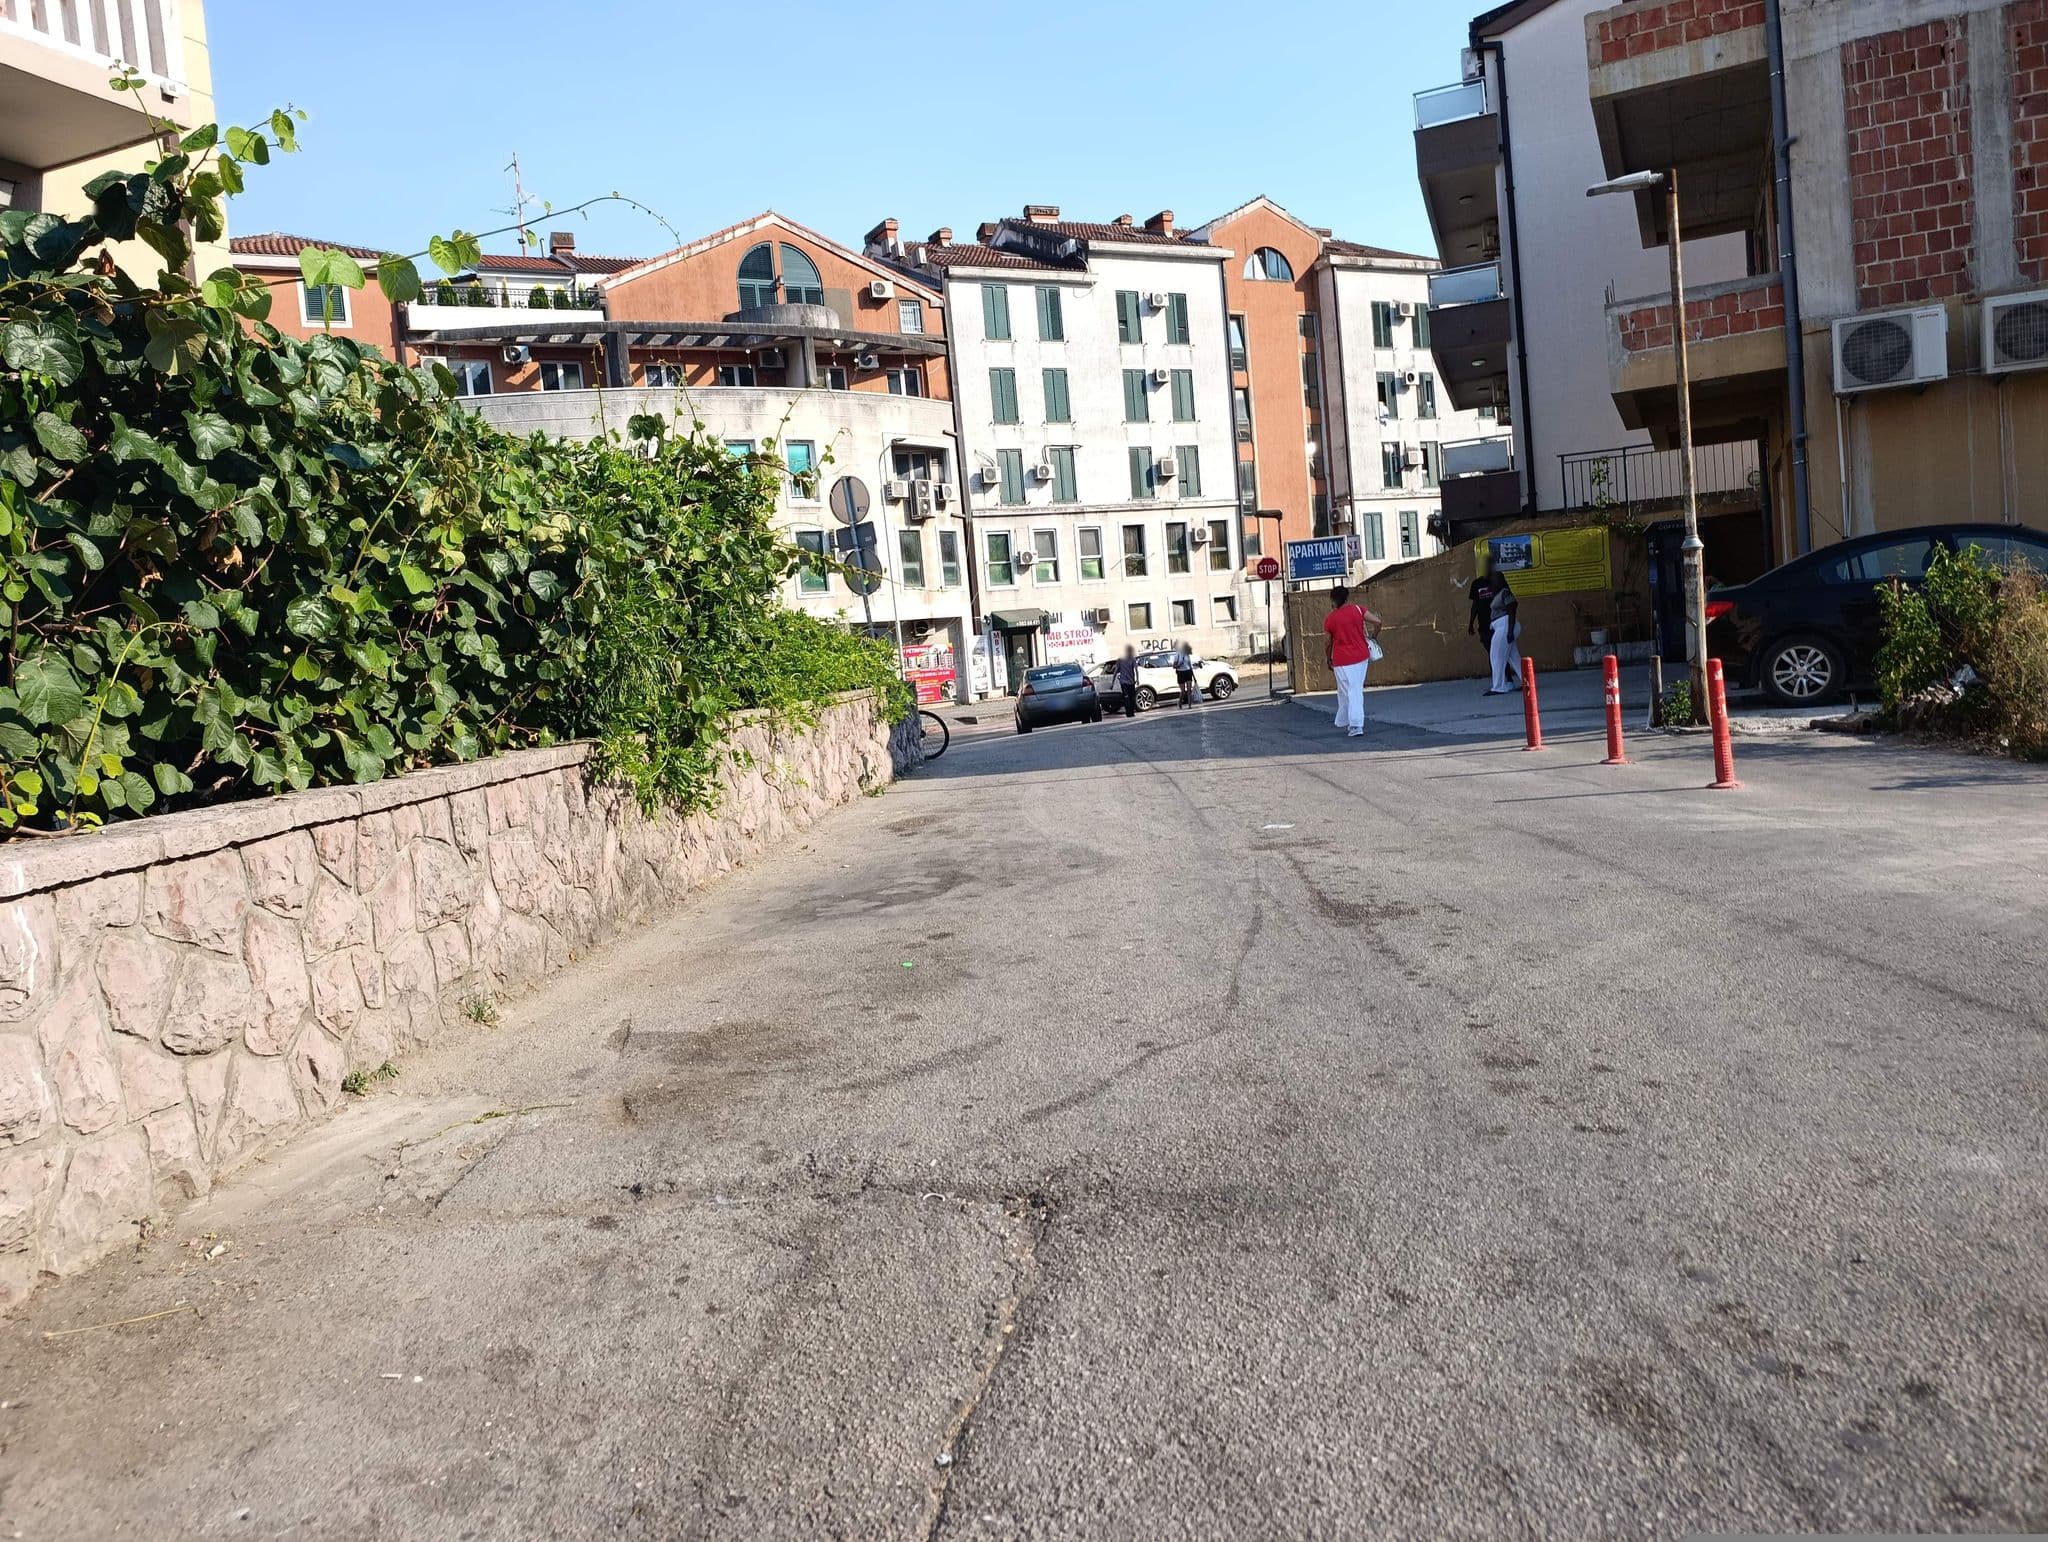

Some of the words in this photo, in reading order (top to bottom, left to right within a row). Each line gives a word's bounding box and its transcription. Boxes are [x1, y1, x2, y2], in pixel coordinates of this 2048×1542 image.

[1289, 541, 1345, 559] APARTMANI
[1258, 564, 1278, 574] STOP
[1046, 632, 1061, 641] MB
[1063, 628, 1093, 640] STROJ
